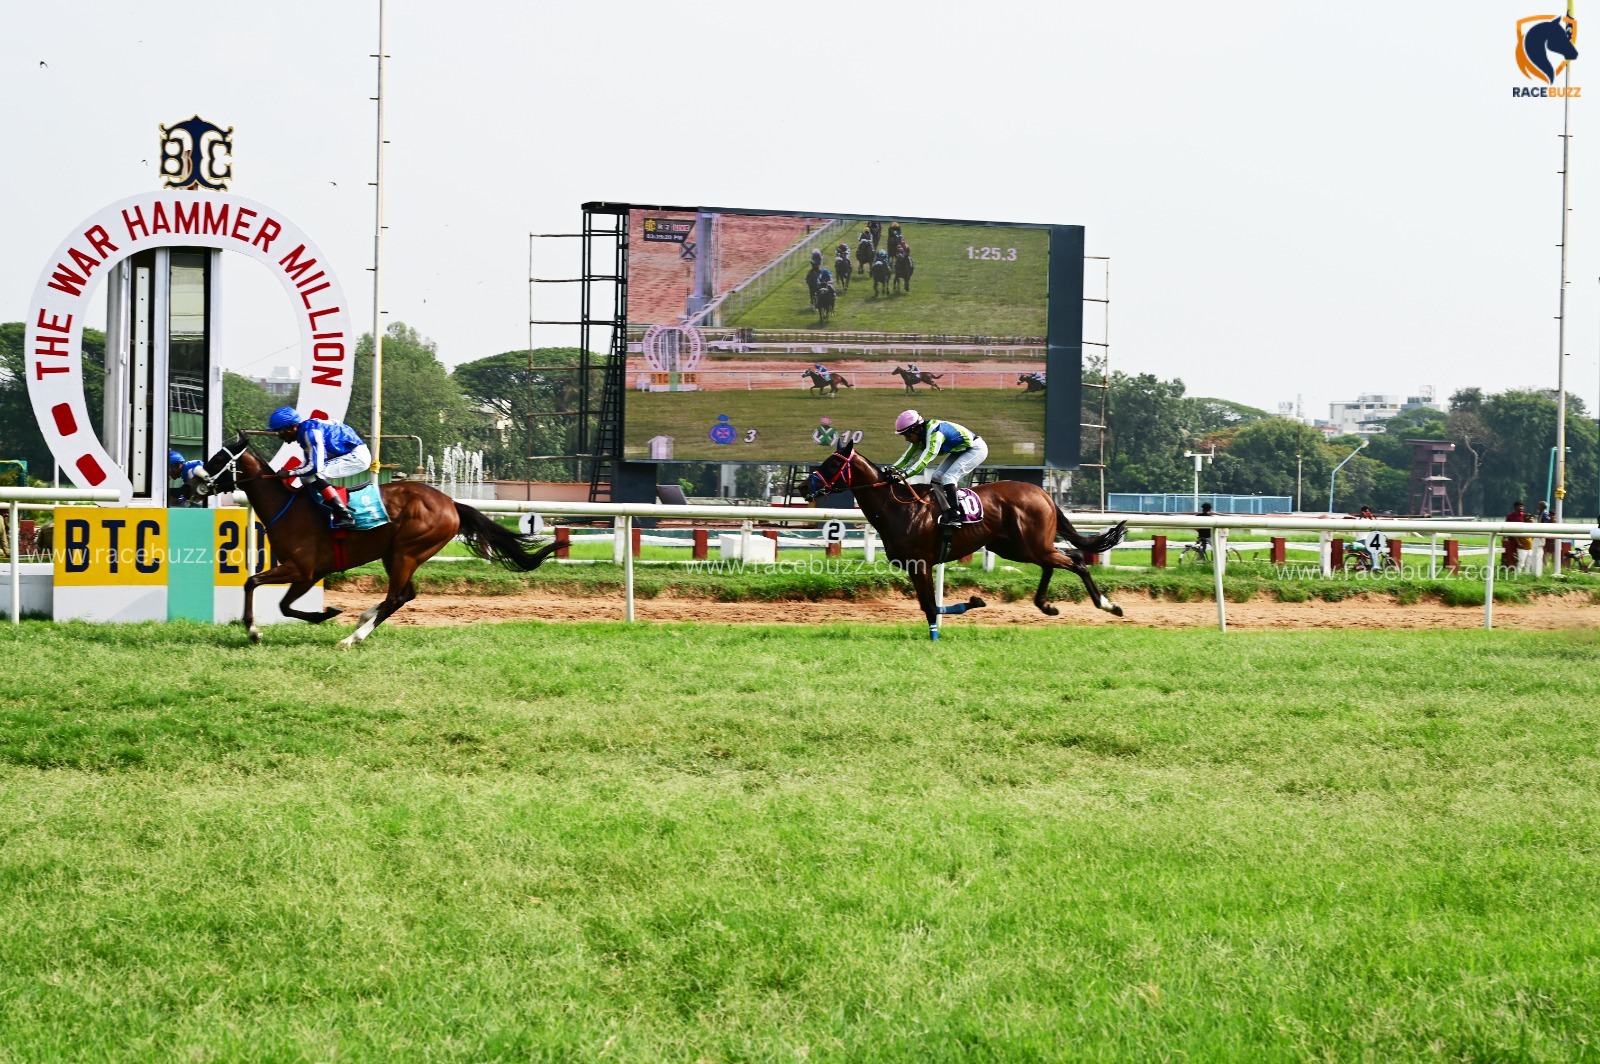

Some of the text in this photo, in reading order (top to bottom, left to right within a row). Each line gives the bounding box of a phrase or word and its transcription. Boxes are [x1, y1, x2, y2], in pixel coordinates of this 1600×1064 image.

[966, 246, 1017, 261] 1:25.3
[35, 201, 345, 387] THE WAR HAMMER MILLION
[743, 429, 758, 443] 3
[841, 430, 864, 444] 10
[958, 495, 980, 515] 10
[527, 515, 535, 534] 1
[828, 522, 840, 541] 2
[65, 519, 160, 573] BTC
[1369, 533, 1381, 550] 4
